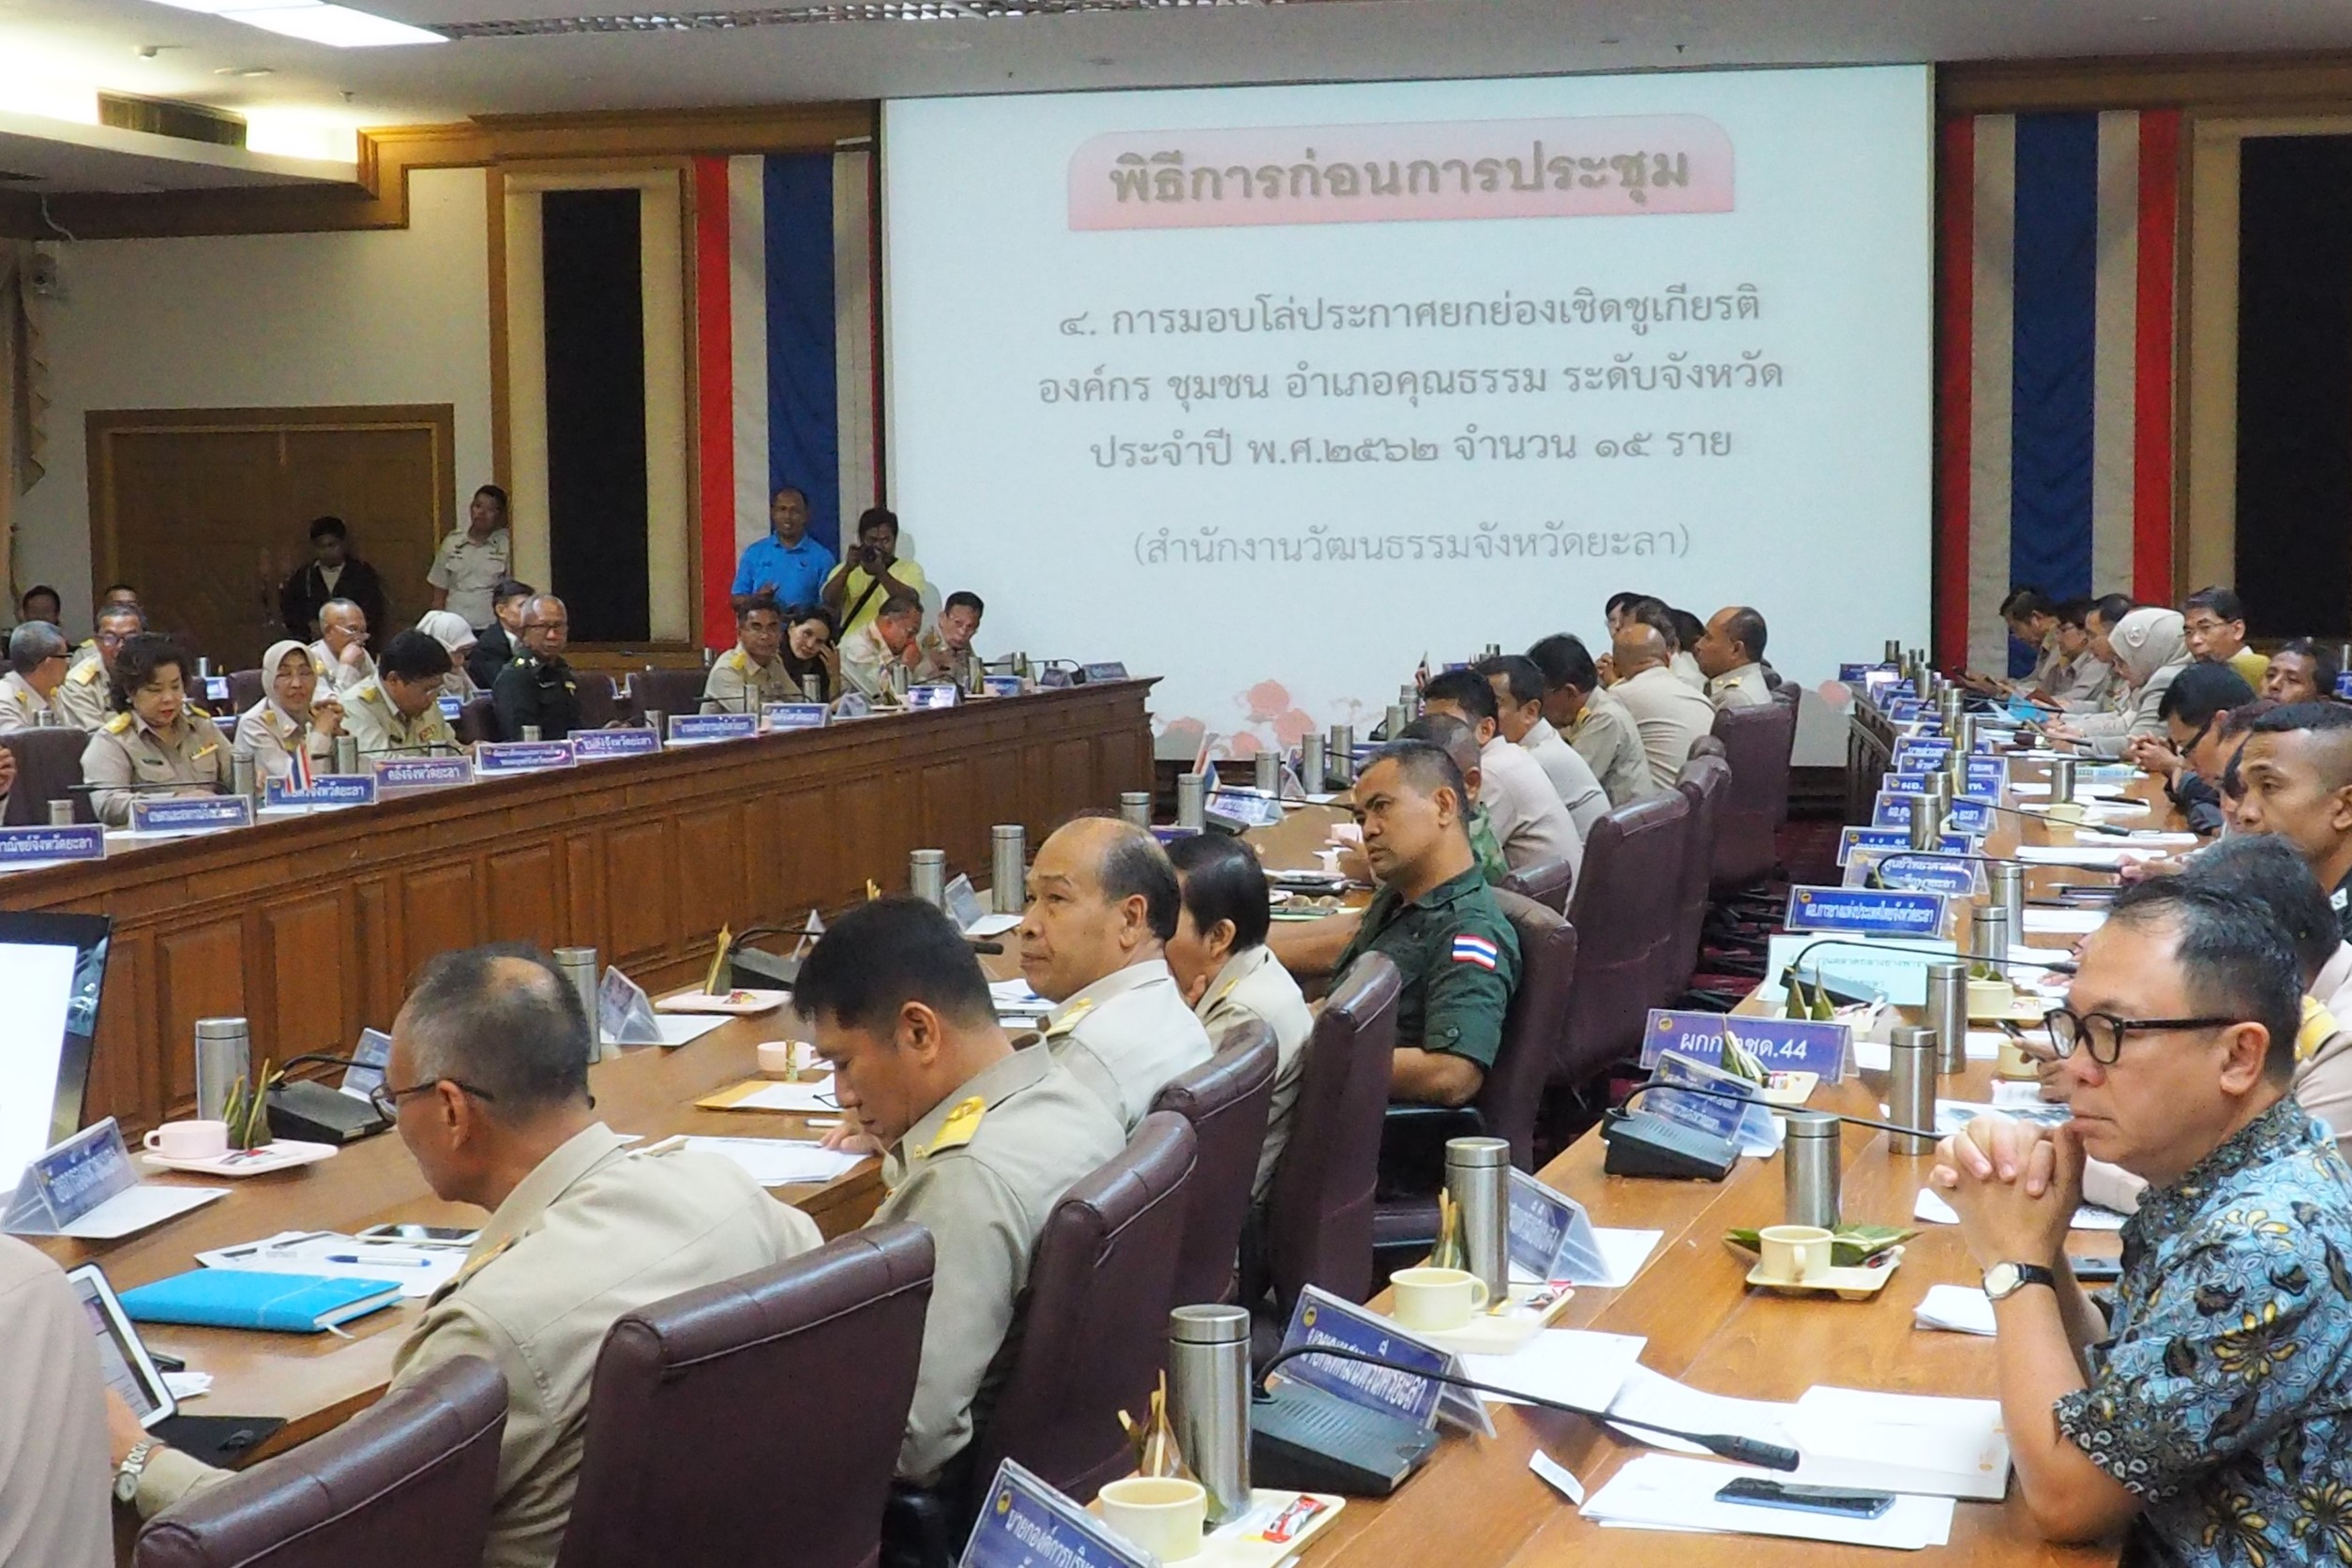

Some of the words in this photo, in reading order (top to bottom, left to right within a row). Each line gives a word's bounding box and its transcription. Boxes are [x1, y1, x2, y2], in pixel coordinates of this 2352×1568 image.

[1109, 141, 1690, 205] พิธีการก่อนการประชุม
[1059, 310, 1097, 337] ๔.
[1112, 282, 1760, 337] การมอบโล่ประกาศยกย่องเชิดชูเกียรติ
[1038, 364, 1152, 404] องค์กร
[1167, 369, 1270, 413] ชุมชน
[1286, 361, 1546, 409] อำเภอคุณธรรม
[1562, 350, 1784, 393] ระดับจังหวัด
[1089, 428, 1232, 469] ประจำปี
[1246, 435, 1440, 465] พ.ศ.๒๕๖๒
[1453, 423, 1577, 461] จำนวน
[1594, 431, 1653, 459] ๑๕
[1666, 430, 1732, 458] ราย
[1134, 520, 1690, 566] (สำนักงานวัฒนธรรมจังหวัดยะลา)
[0, 832, 93, 854] าณิชย์จังหวัดยะลา
